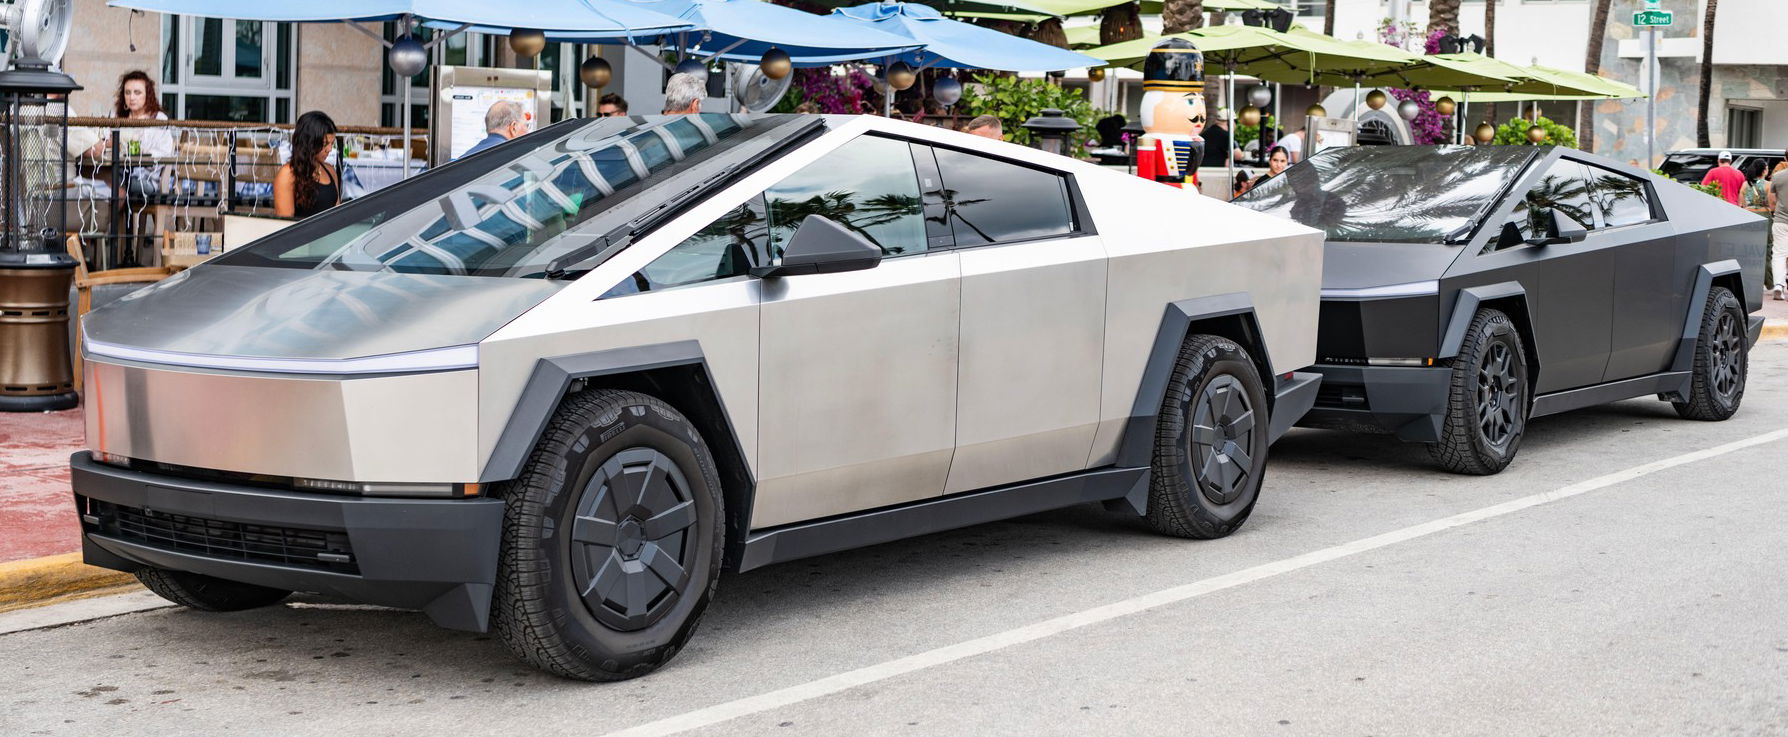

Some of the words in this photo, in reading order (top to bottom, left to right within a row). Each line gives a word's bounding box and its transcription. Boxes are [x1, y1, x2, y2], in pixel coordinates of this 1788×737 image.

[1637, 14, 1646, 24] 12
[1650, 15, 1669, 23] Street
[600, 422, 626, 443] PIRELLI
